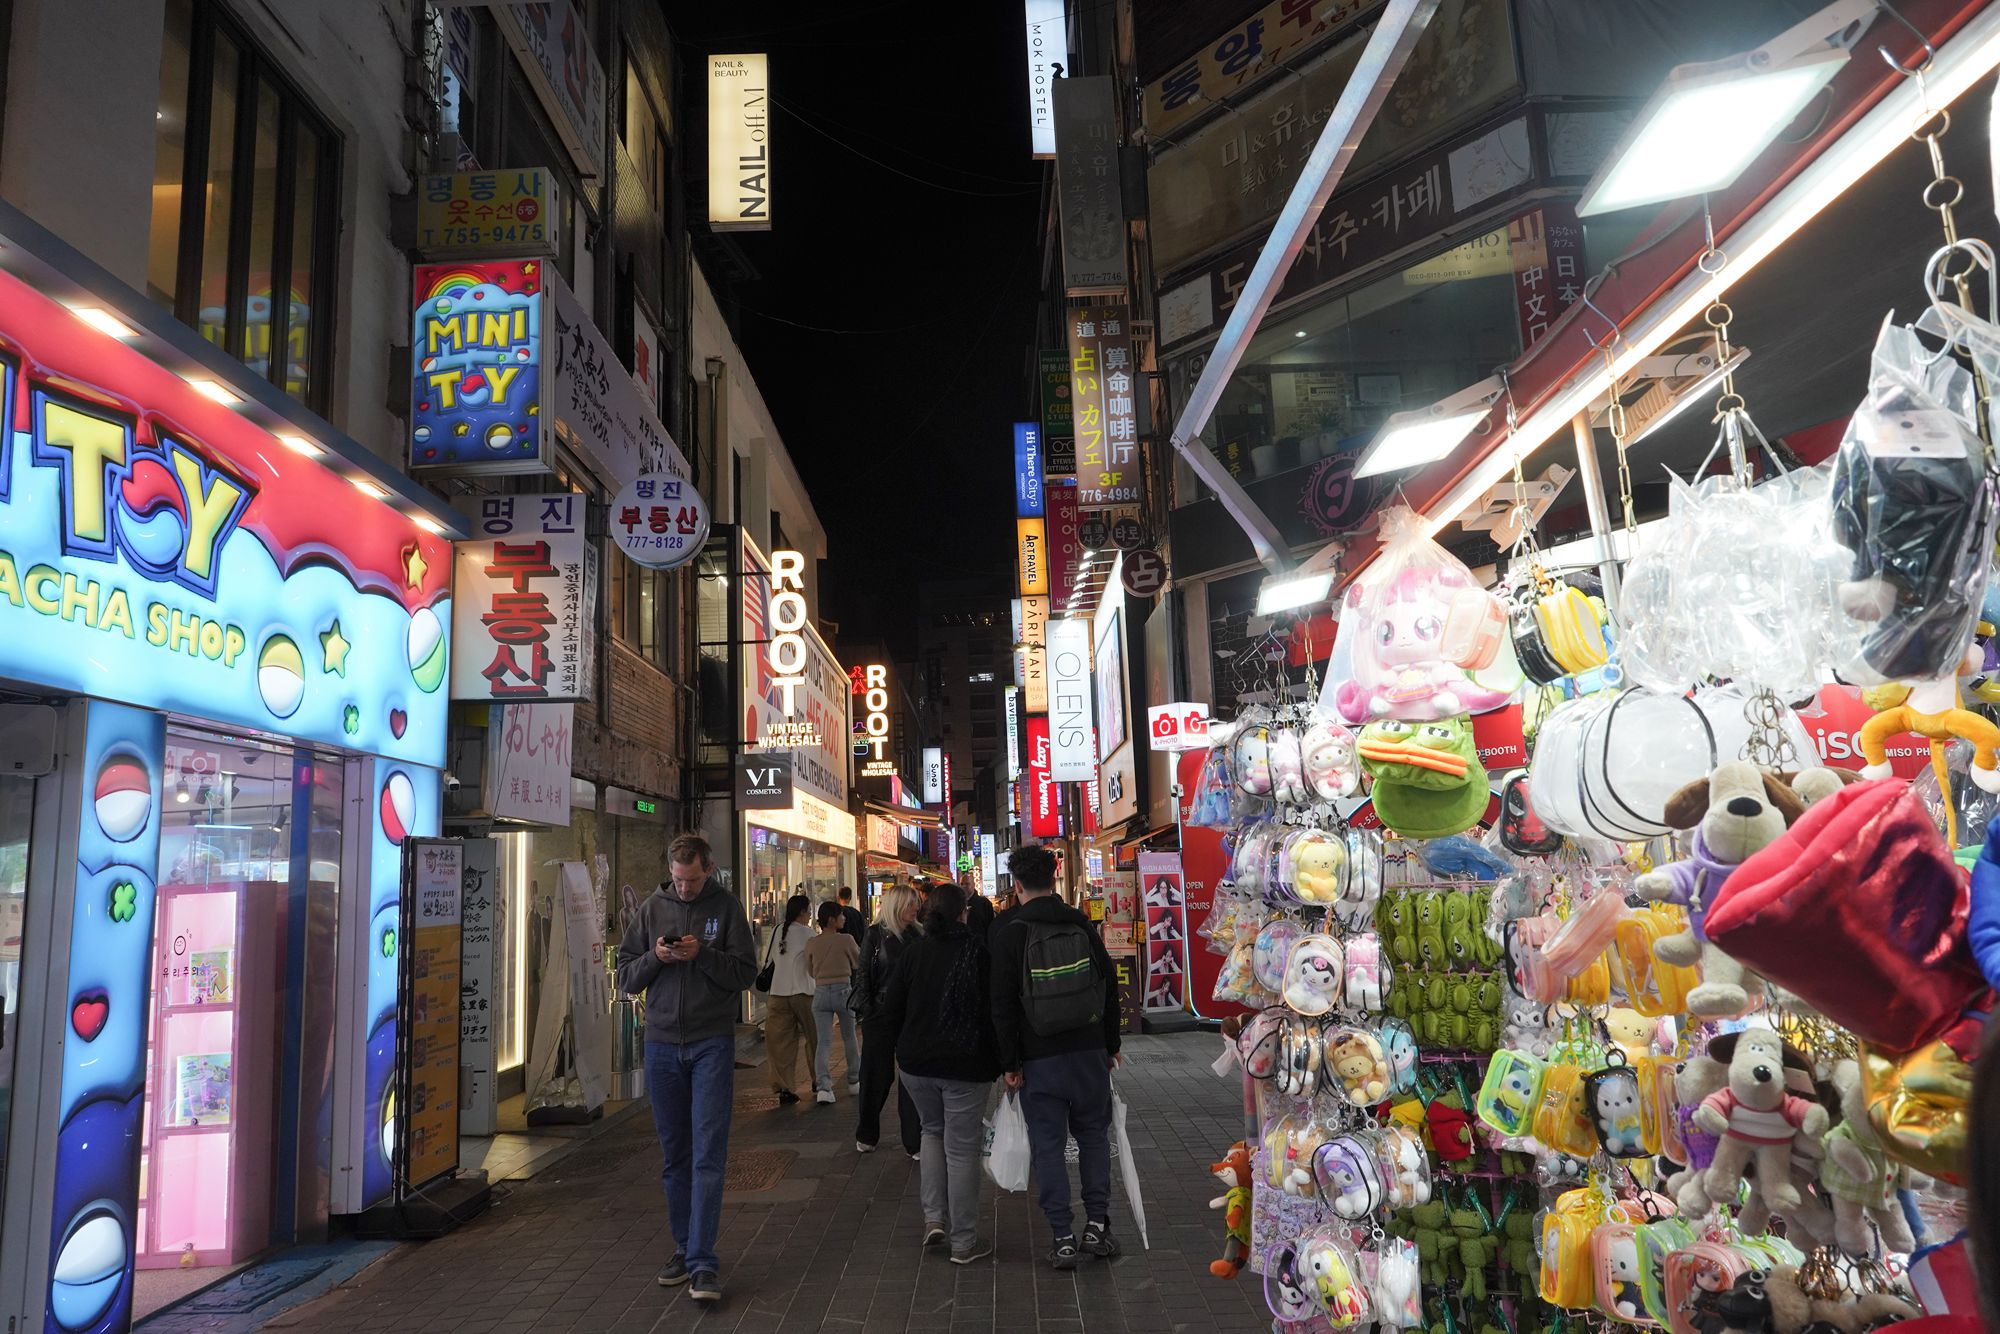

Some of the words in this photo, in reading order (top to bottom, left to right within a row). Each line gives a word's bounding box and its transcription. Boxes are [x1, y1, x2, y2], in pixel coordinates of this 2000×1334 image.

[1032, 25, 1043, 57] MOK
[1035, 64, 1046, 124] HOSTEL
[739, 145, 767, 218] NAIL
[427, 307, 528, 355] MINI
[1026, 431, 1035, 444] Hi
[1026, 446, 1037, 477] There
[636, 479, 682, 499] 명진
[1081, 487, 1138, 502] 776-4984
[1099, 472, 1123, 487] 3F
[481, 496, 575, 535] 명진
[618, 505, 699, 534] 부동산
[626, 536, 683, 549] 777-8128
[1115, 526, 1140, 542] 타로
[1025, 534, 1039, 585] ARTRAVEL
[1130, 553, 1160, 589] 占
[145, 600, 247, 668] SHOP
[480, 541, 560, 698] 부동산
[770, 550, 807, 717] ROOT
[866, 664, 889, 760] ROOT
[1055, 652, 1085, 747] OLENS
[758, 735, 823, 748] WHOLESALE
[767, 723, 813, 735] VINTAGE
[1031, 735, 1050, 768] Lazy
[1885, 748, 1912, 757] MISO
[746, 768, 782, 787] VT
[1186, 881, 1203, 889] OPEN
[1187, 902, 1210, 910] HOURS
